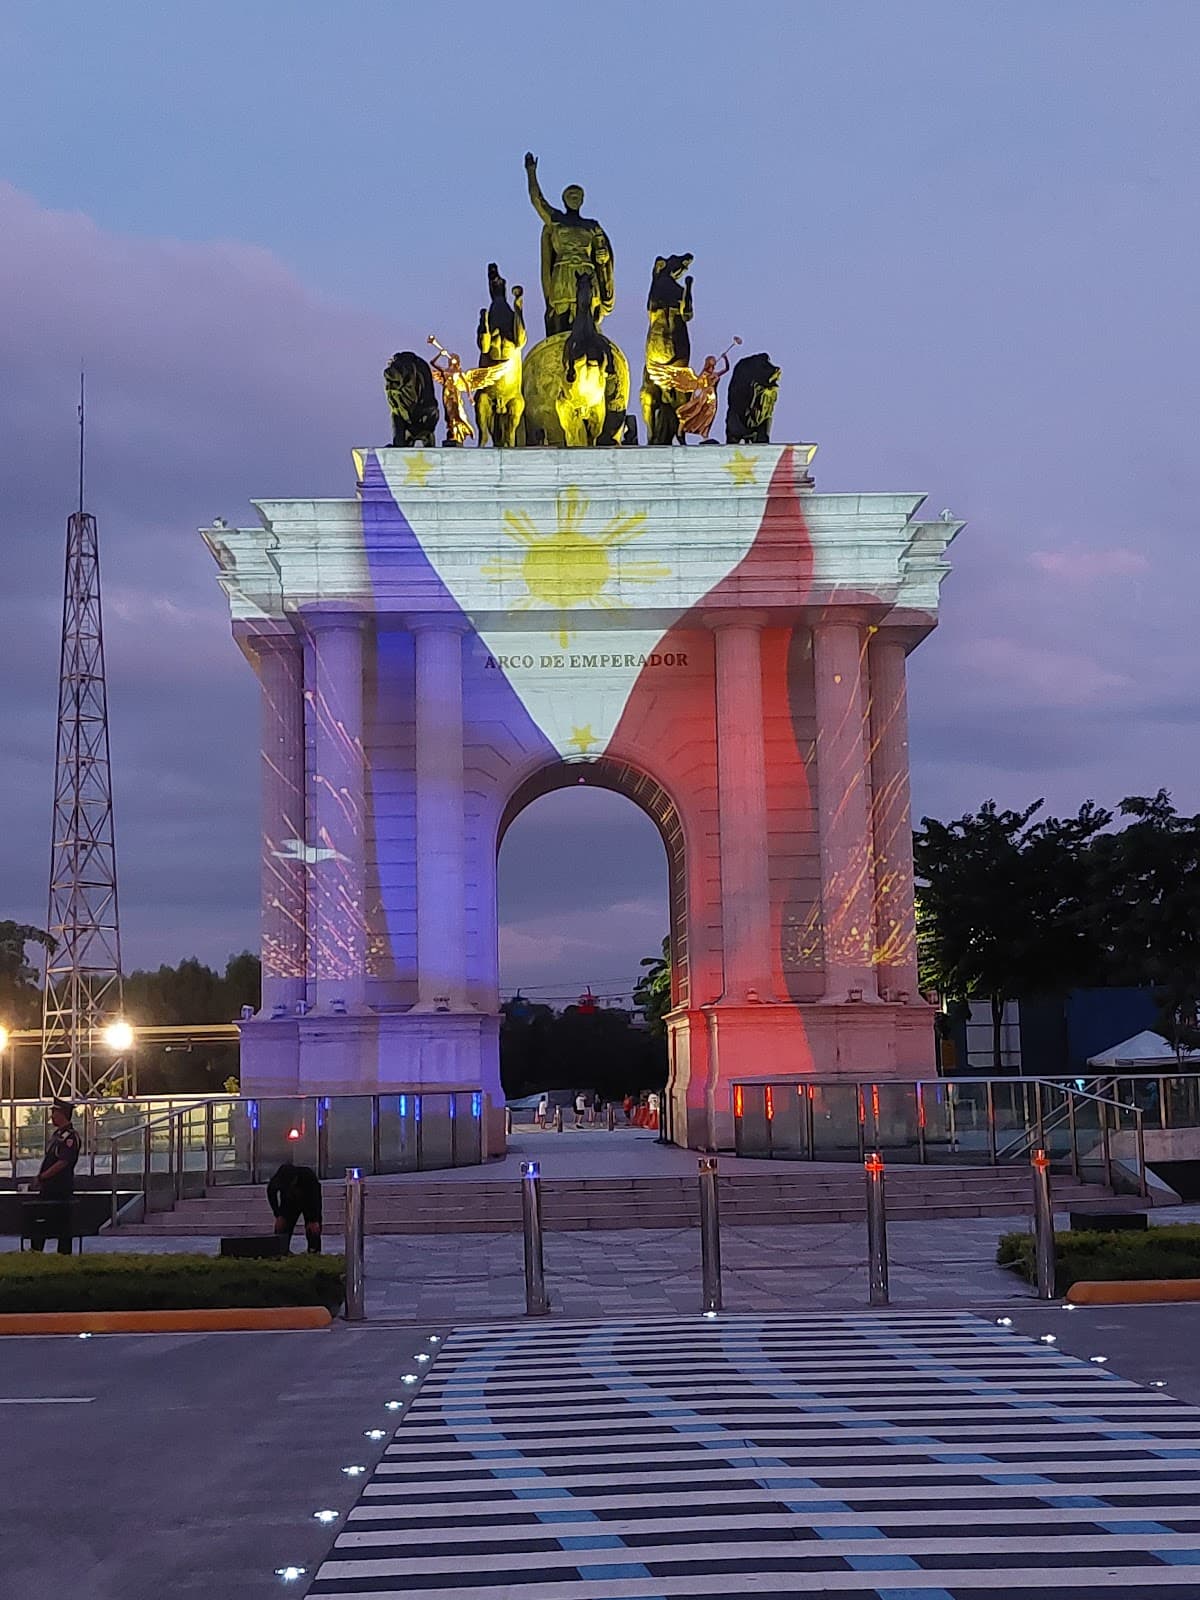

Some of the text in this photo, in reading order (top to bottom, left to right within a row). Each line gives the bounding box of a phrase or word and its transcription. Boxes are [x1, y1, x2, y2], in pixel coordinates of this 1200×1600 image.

[485, 653, 689, 669] ARCO DE EMPERADOR
